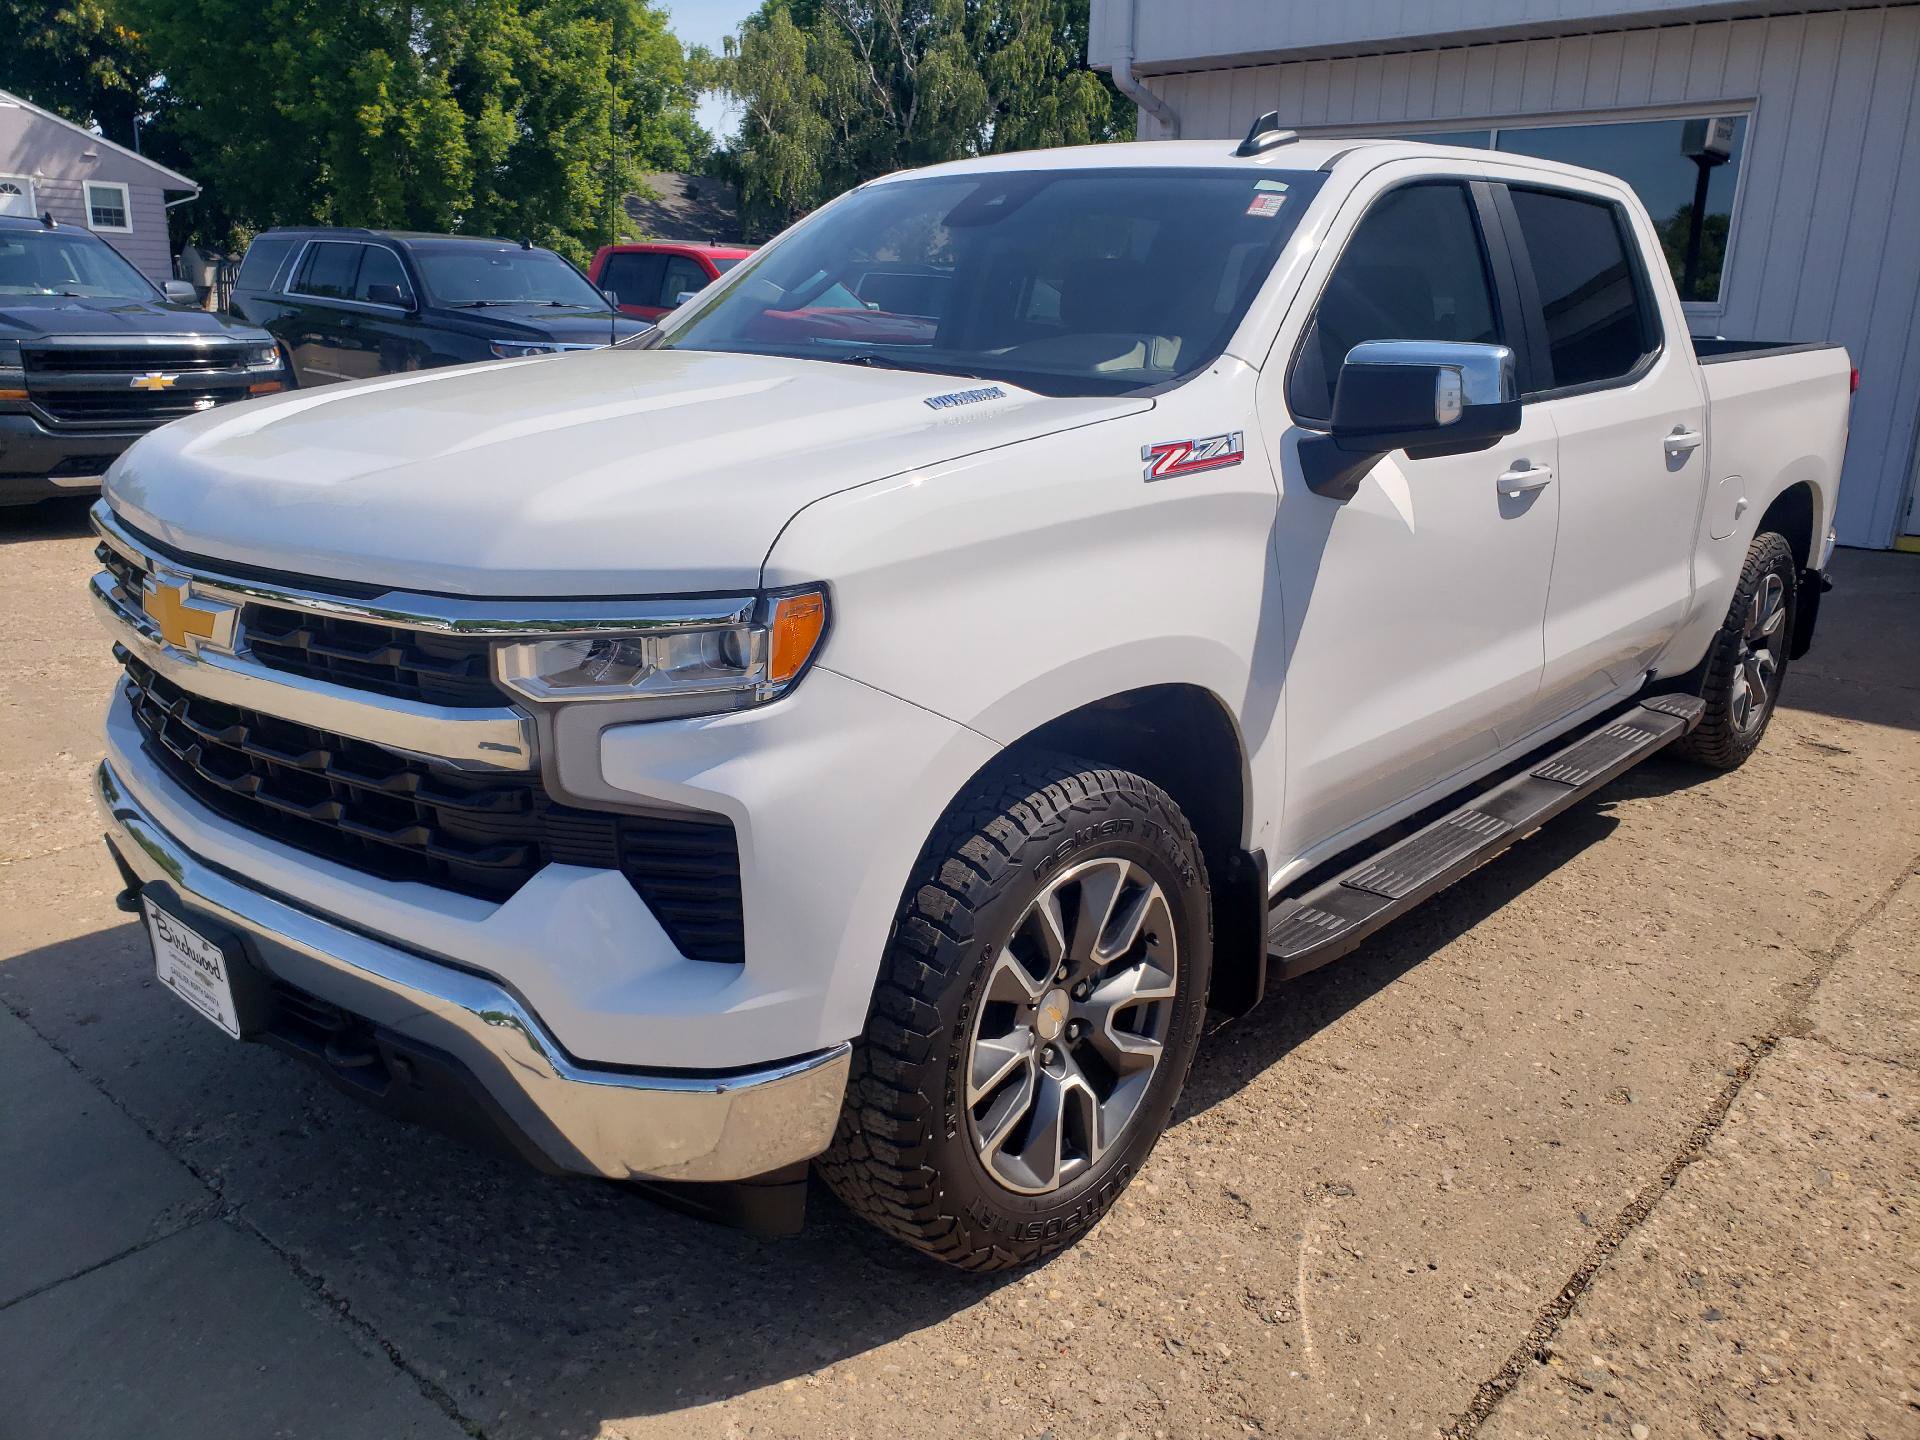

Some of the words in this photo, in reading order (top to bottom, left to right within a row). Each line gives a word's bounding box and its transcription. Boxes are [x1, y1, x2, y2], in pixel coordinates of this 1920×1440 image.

[1140, 430, 1245, 483] Z71
[151, 910, 224, 982] Birchwood
[1008, 1163, 1132, 1243] OUTPOST
